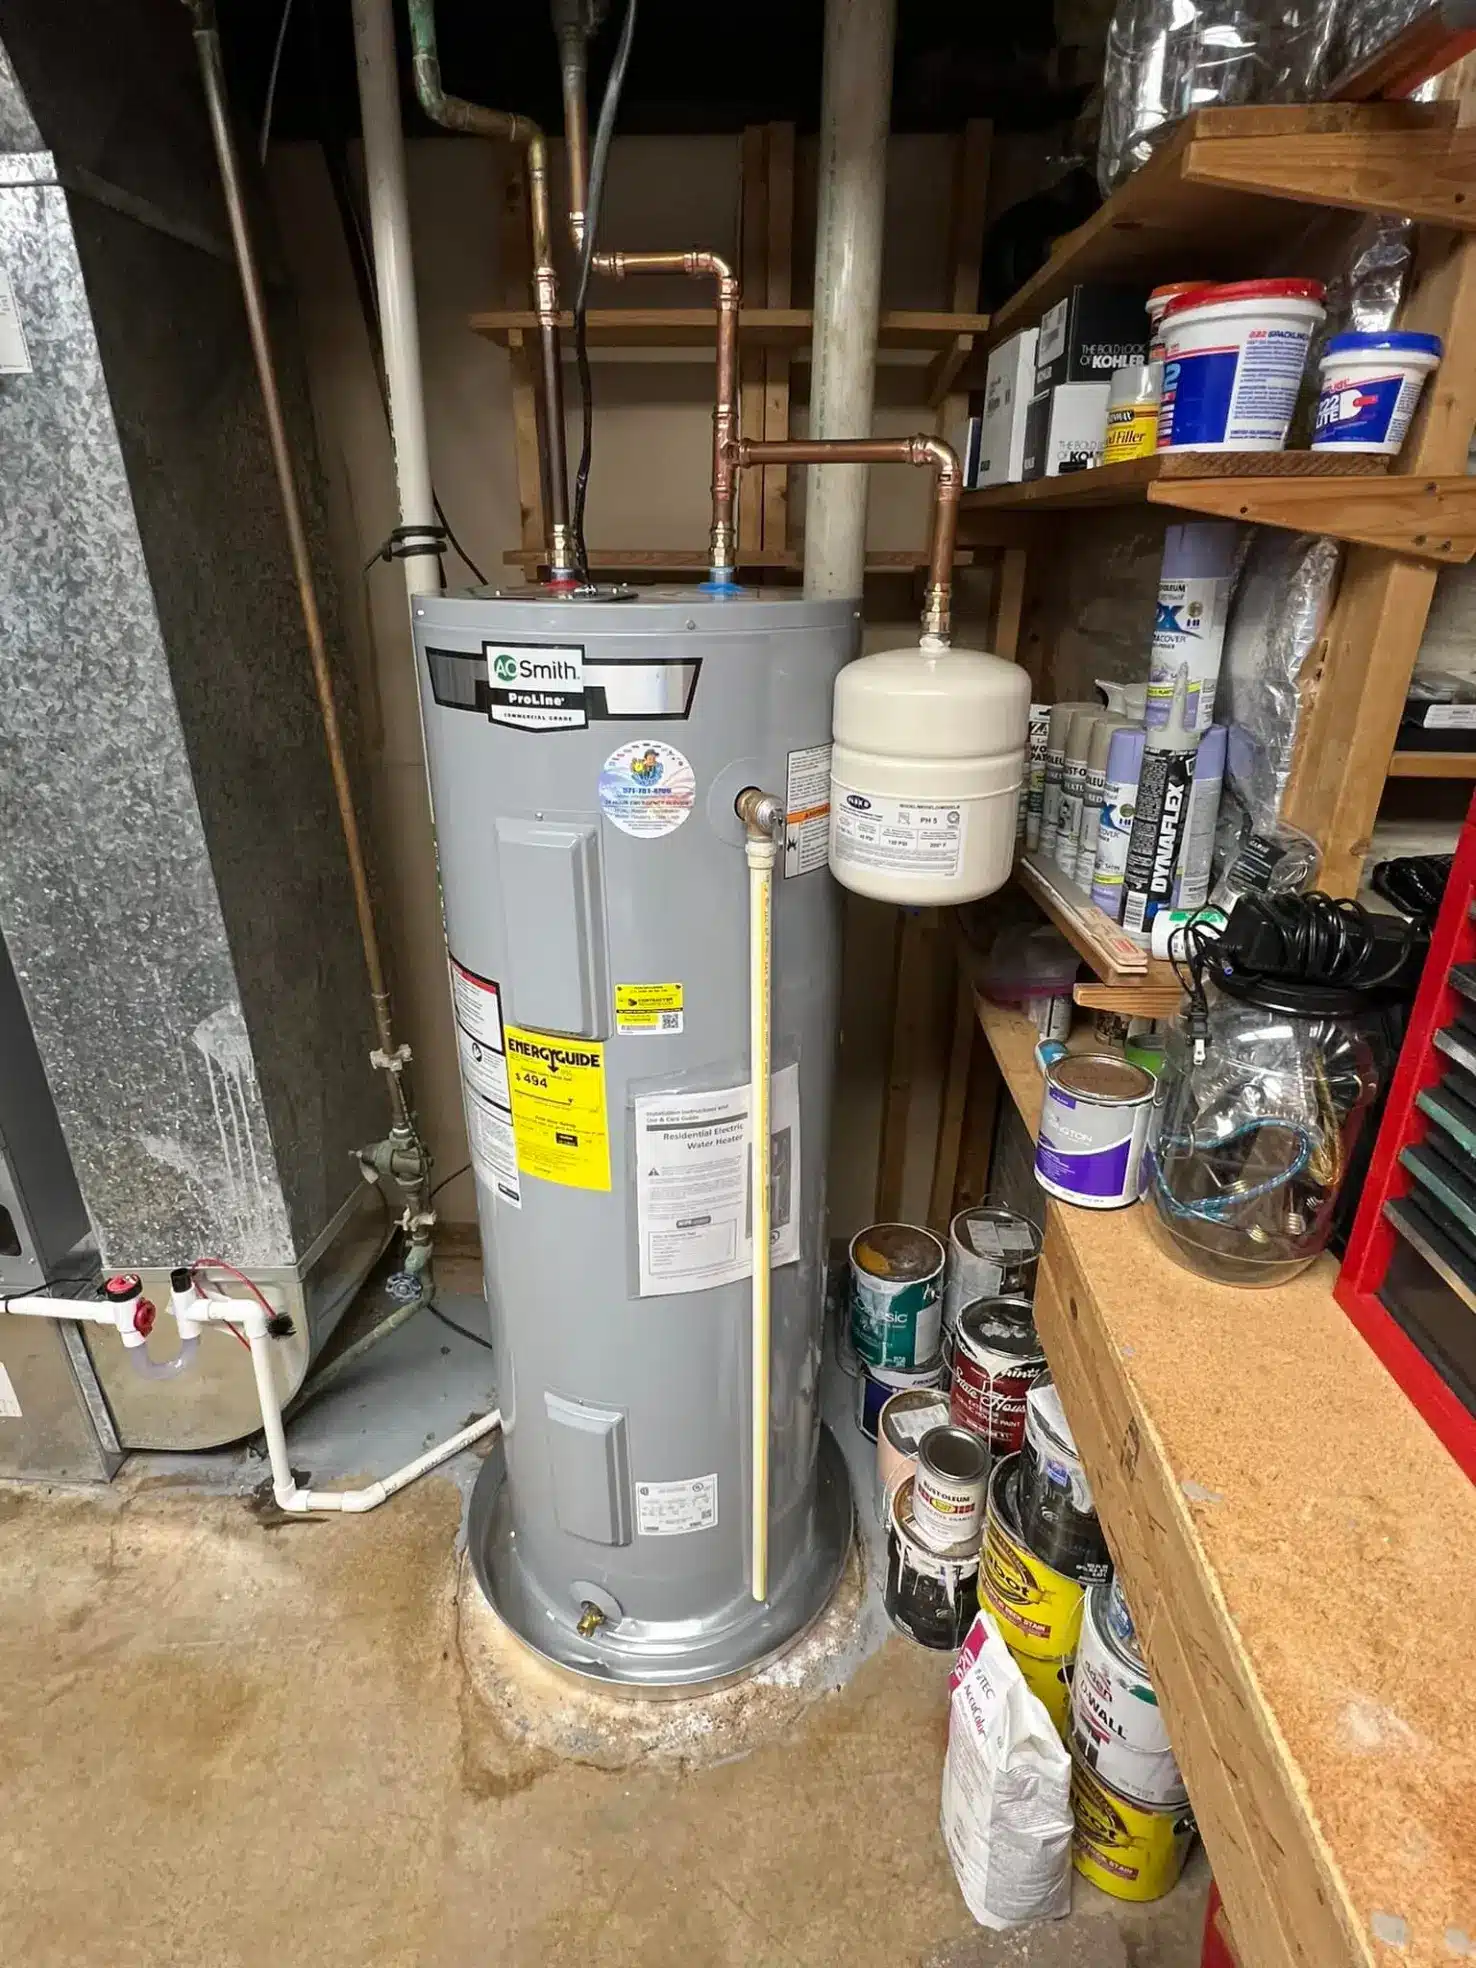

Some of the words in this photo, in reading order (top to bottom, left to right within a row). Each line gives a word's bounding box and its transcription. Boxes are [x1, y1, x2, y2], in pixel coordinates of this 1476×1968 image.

[1082, 344, 1097, 354] THE
[1098, 344, 1120, 354] BOLD
[1092, 354, 1145, 368] KOHLER
[1117, 430, 1146, 445] Filler
[520, 660, 577, 681] Smith
[508, 692, 565, 706] ProLine
[1150, 782, 1184, 893] DYNAFLEX
[508, 1037, 600, 1069] ENERGYGUIDE
[523, 1073, 548, 1088] 494
[663, 1128, 712, 1141] Residential
[714, 1123, 744, 1135] Electric
[687, 1141, 713, 1150] Water
[715, 1134, 744, 1146] Heater
